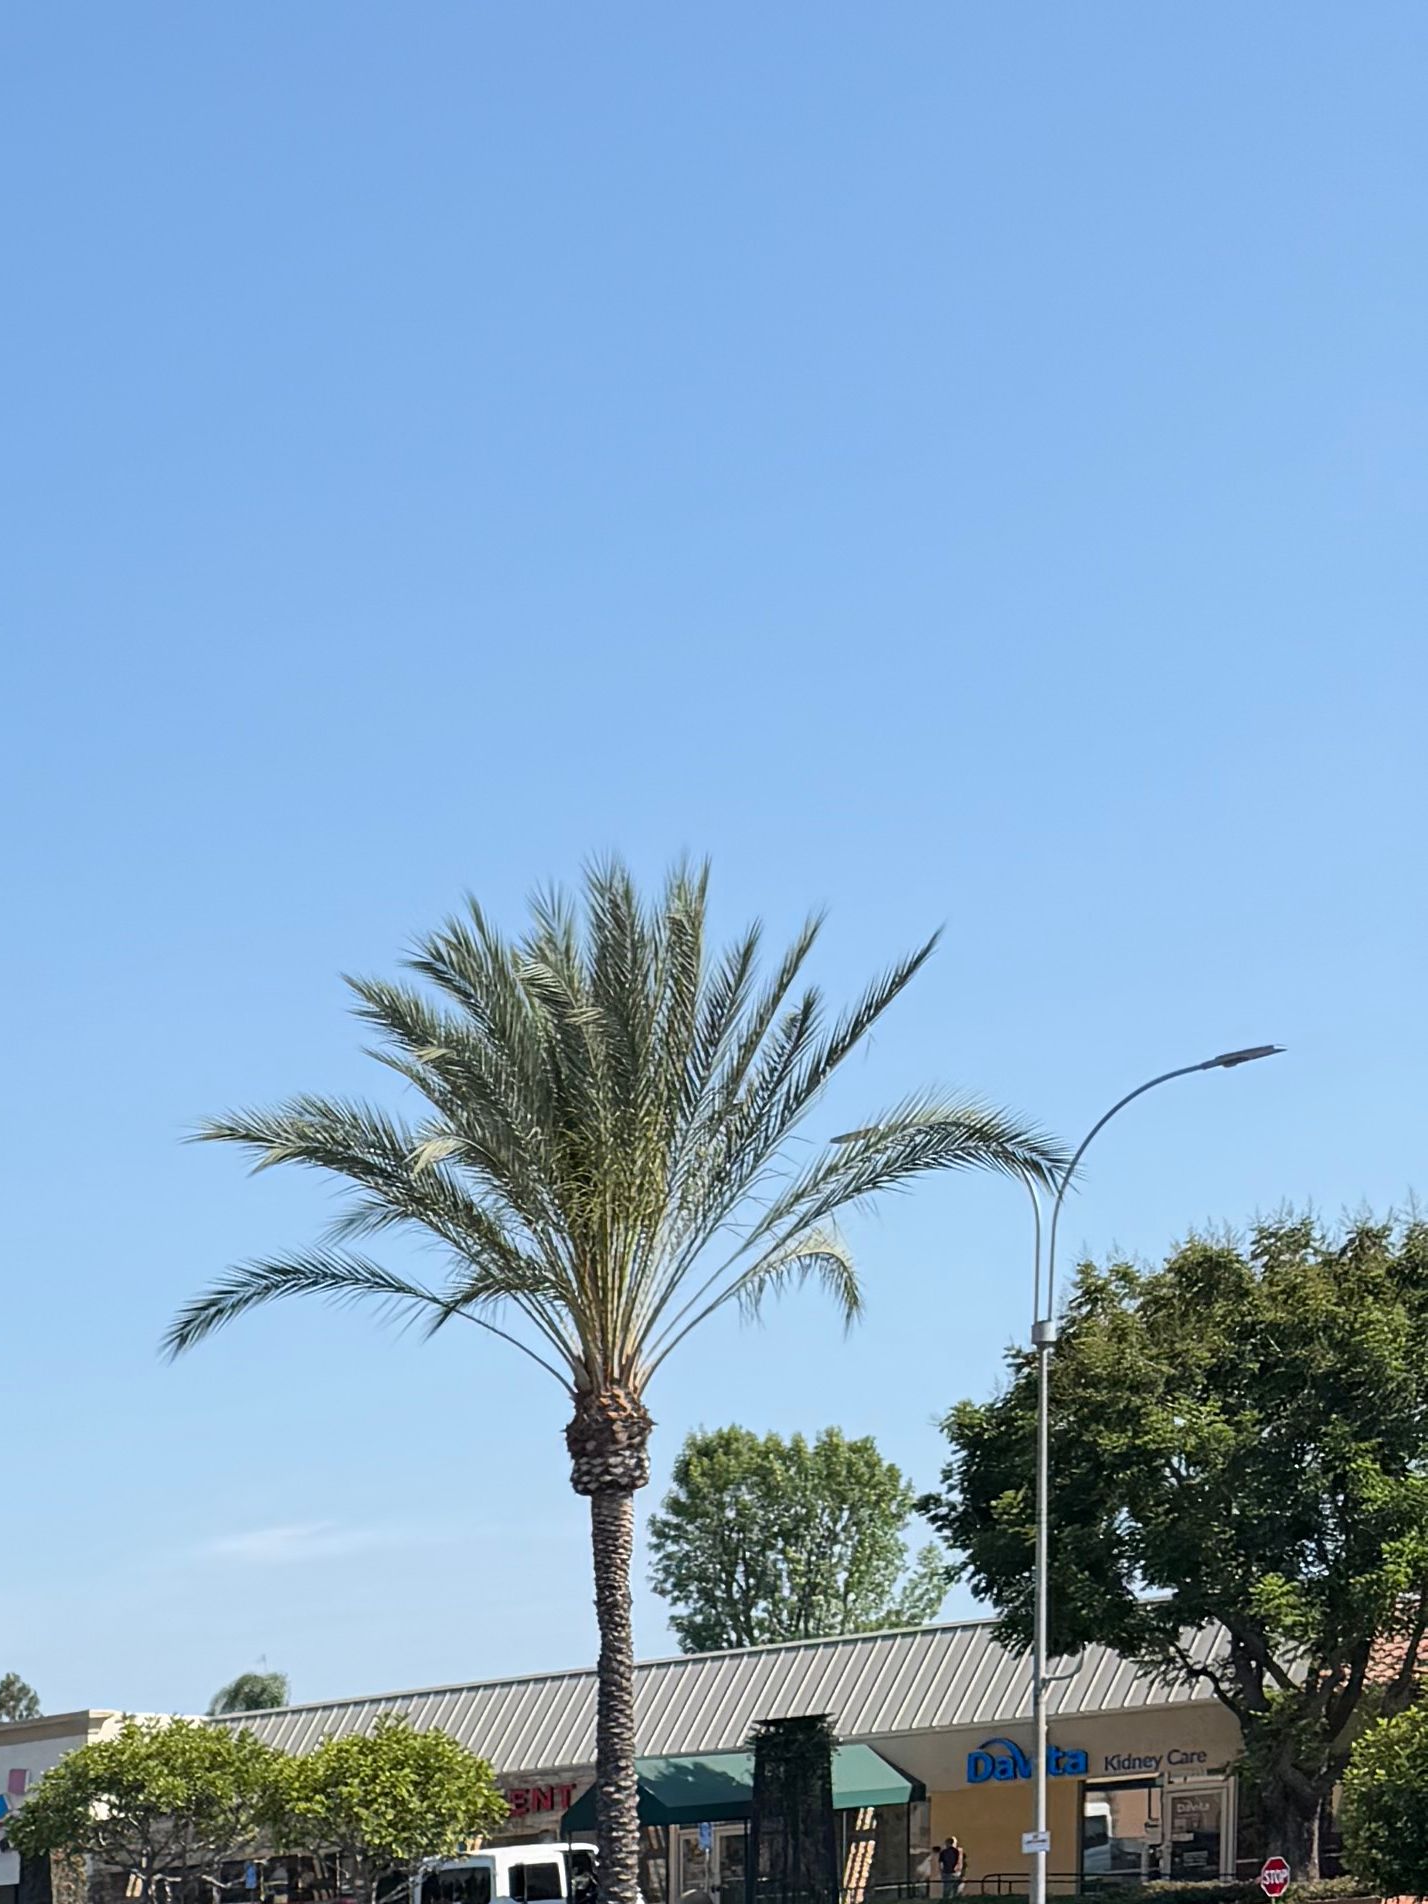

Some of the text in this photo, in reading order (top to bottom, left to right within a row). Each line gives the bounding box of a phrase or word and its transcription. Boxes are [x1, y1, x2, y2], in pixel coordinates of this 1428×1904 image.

[967, 1738, 1207, 1783] DaVta Kidney Care
[509, 1782, 577, 1818] ENT
[1263, 1869, 1289, 1885] STOP
